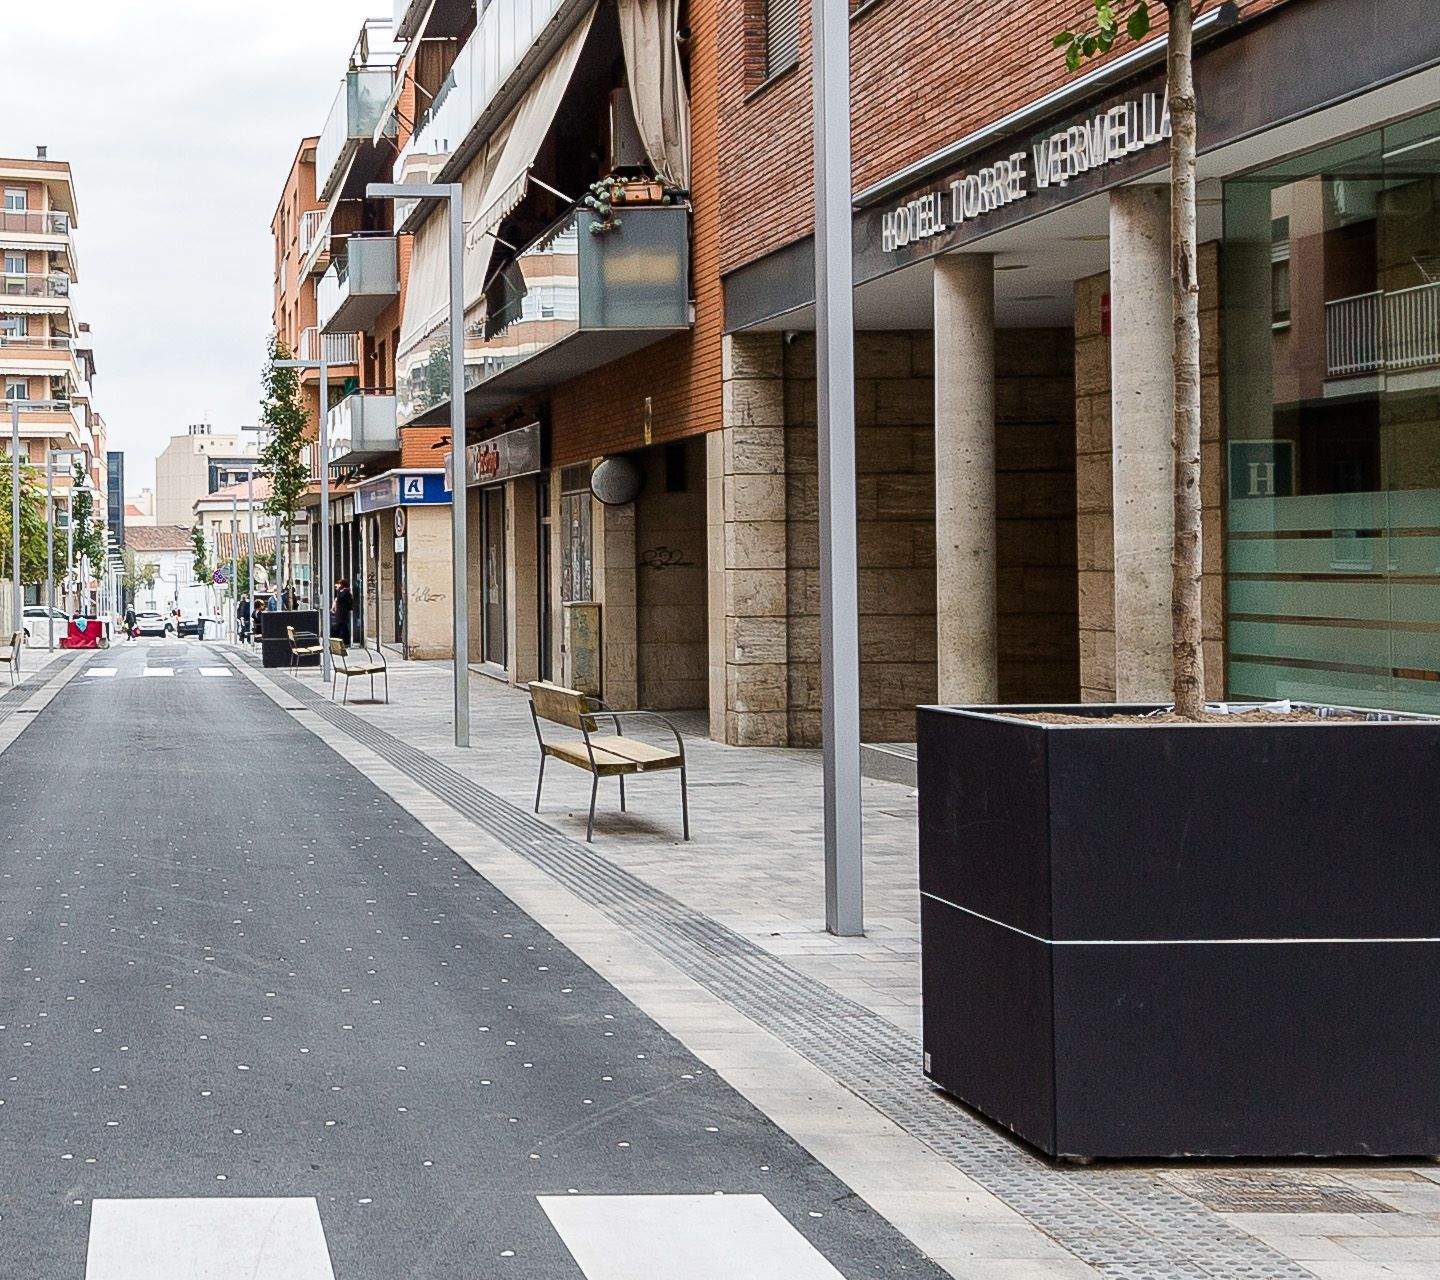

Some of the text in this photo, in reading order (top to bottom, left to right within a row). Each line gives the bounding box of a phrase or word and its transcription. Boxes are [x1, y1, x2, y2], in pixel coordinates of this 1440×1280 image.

[881, 191, 947, 253] HOTEL
[949, 151, 1028, 224] TORRE
[1247, 462, 1277, 496] H
